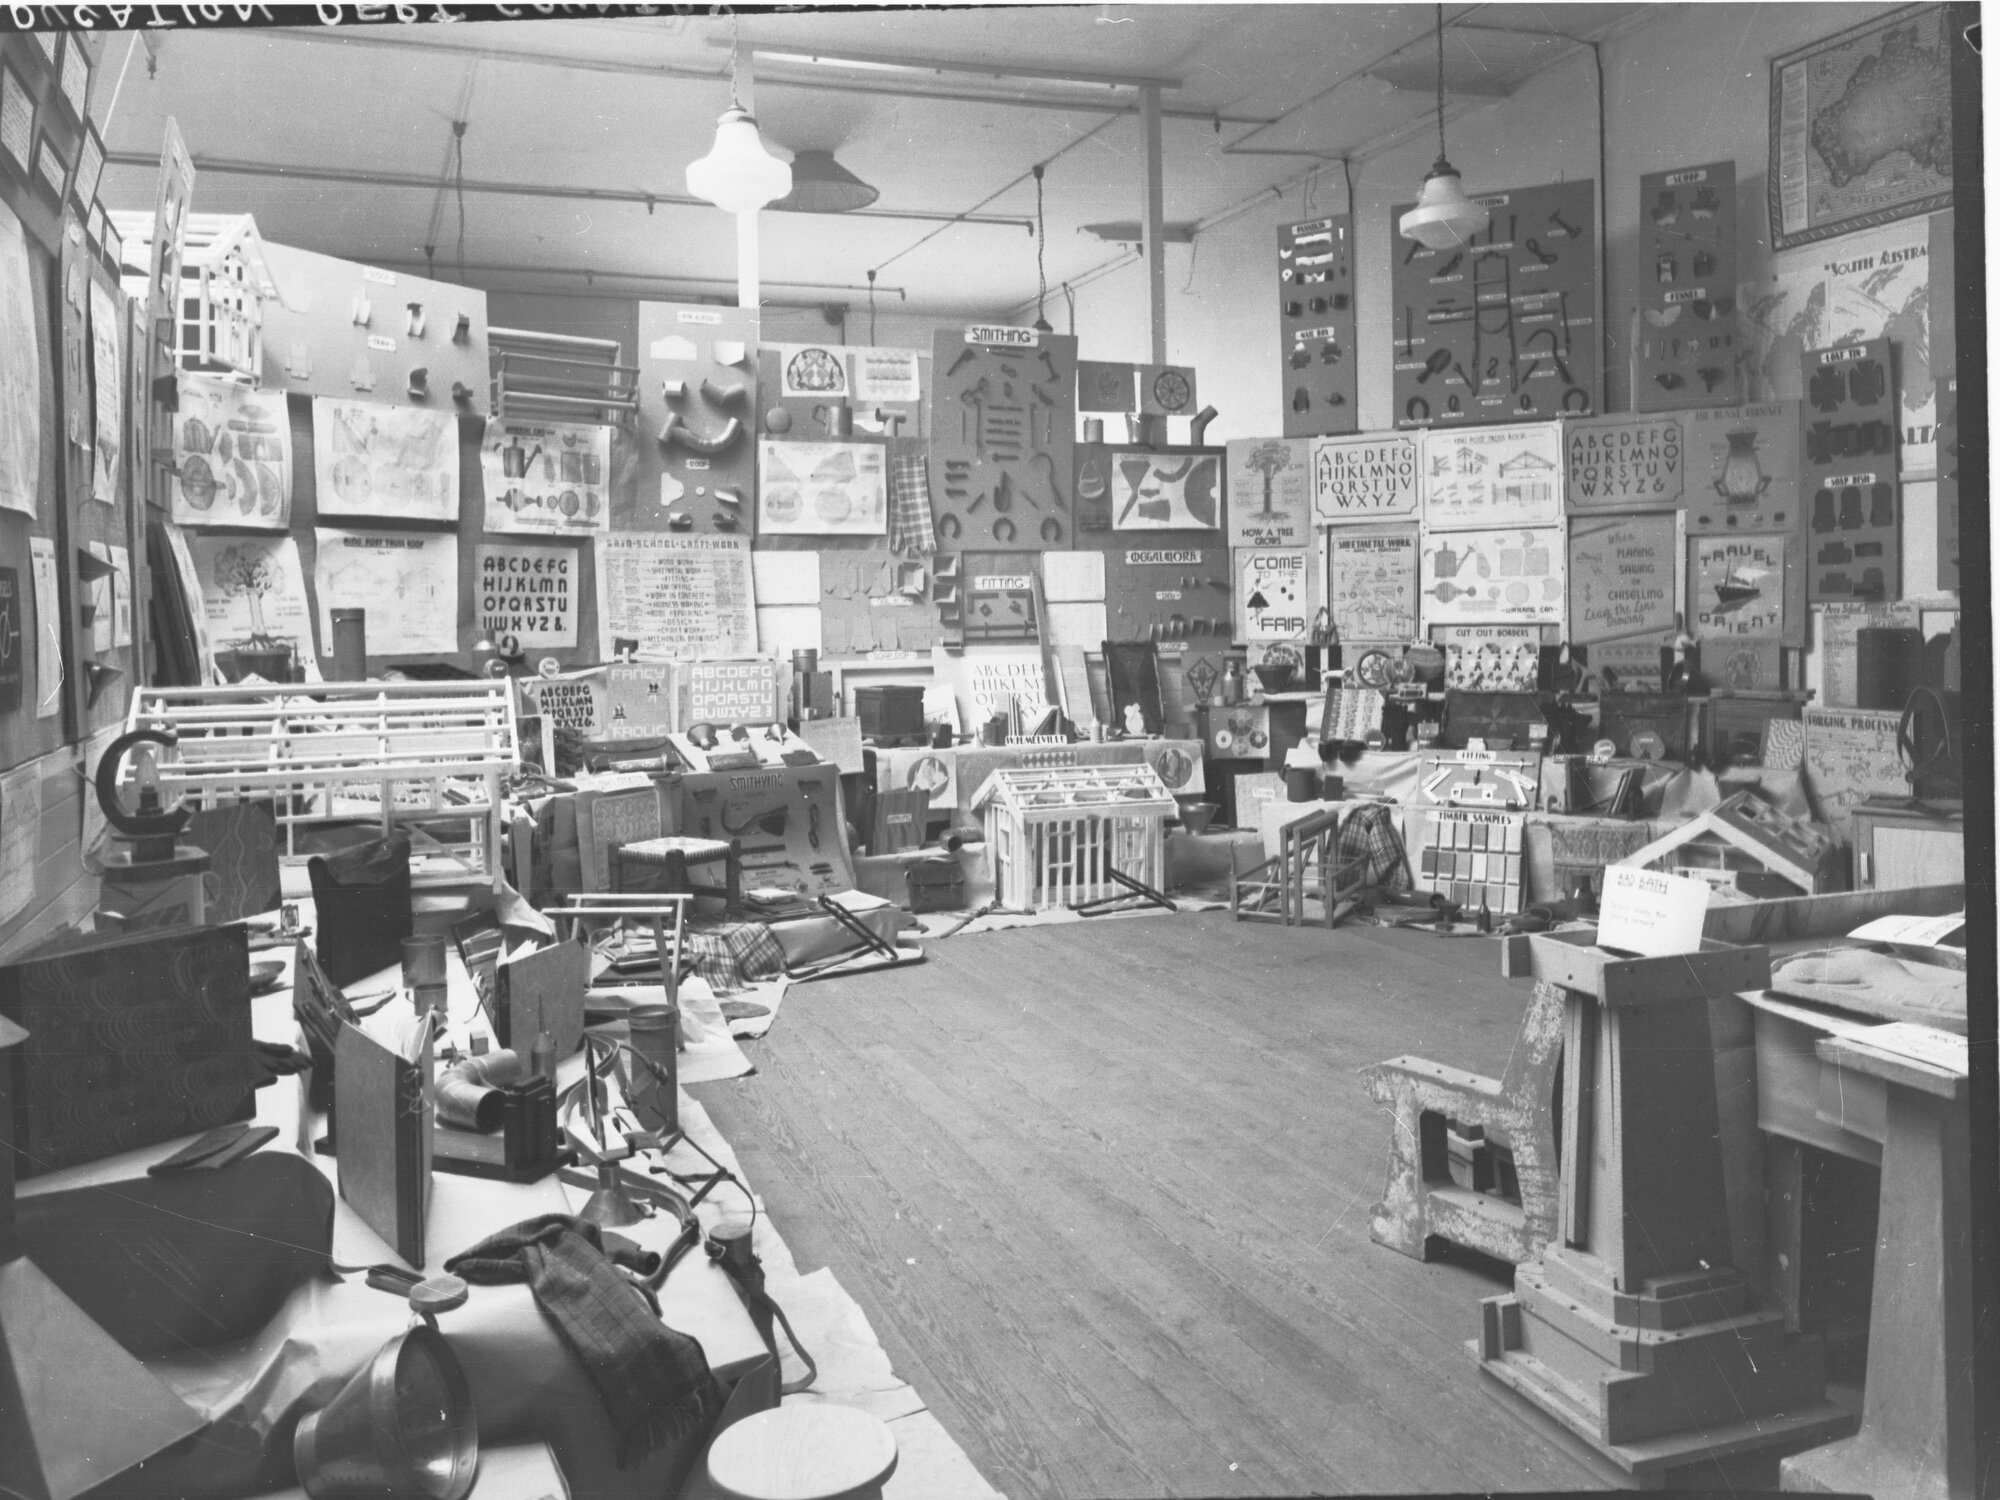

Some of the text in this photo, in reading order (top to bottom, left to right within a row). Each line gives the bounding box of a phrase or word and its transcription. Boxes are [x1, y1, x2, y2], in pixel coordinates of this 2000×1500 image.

[1880, 244, 1928, 267] AUSTRA
[972, 327, 1031, 343] SMITHING
[1242, 528, 1294, 537] HOW A TREE
[1255, 537, 1282, 545] GROWS
[1700, 545, 1777, 567] TRAVEL
[1254, 556, 1303, 570] COME
[981, 577, 1024, 588] FITTING
[1607, 589, 1665, 601] CHISELLING
[1260, 617, 1305, 632] FAIR
[1699, 612, 1777, 634] ORIENT
[1456, 629, 1529, 637] CUT OUT BORDERS
[611, 668, 665, 680] FANCY
[1808, 715, 1847, 729] FORGING
[613, 725, 667, 738] FROLIC
[1462, 751, 1491, 760] FITTING
[730, 773, 784, 791] SMITHYING
[1439, 812, 1512, 825] TIMBER SAMPLES
